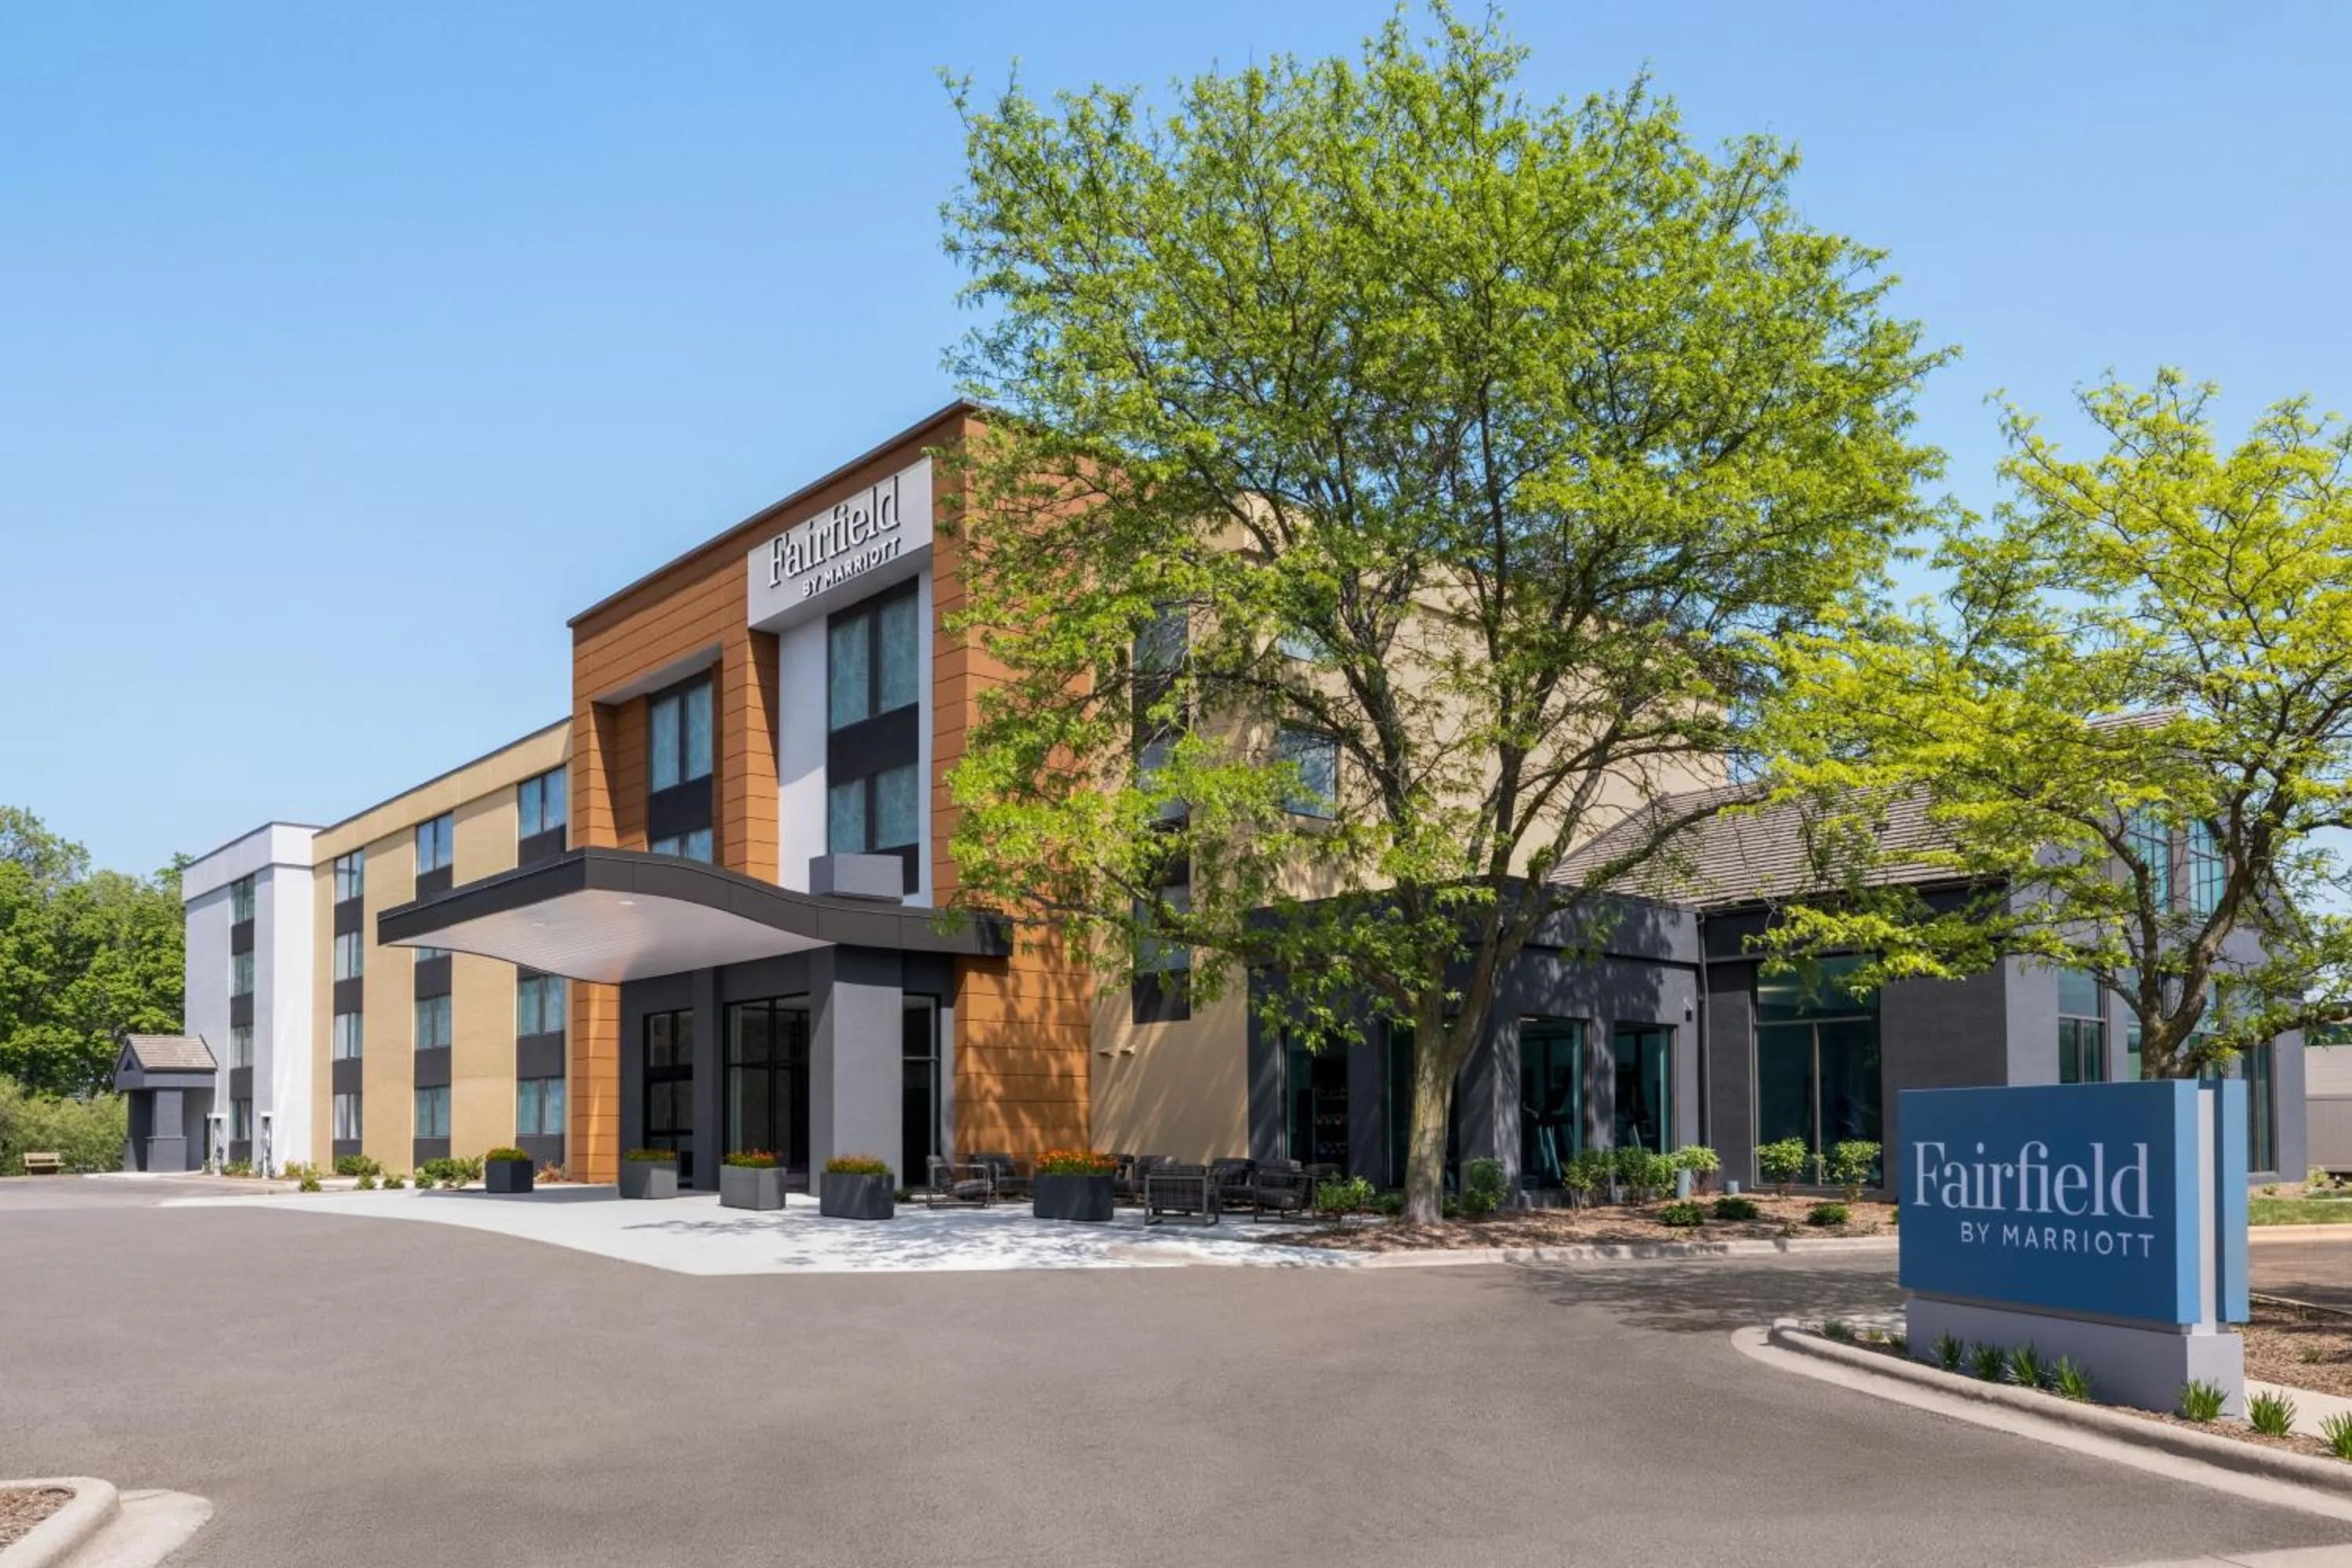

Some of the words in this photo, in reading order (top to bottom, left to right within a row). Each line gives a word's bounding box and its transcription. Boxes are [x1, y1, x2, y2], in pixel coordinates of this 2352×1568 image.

[768, 475, 900, 588] Fairfield
[803, 575, 821, 597] BY
[825, 537, 901, 587] MARRIOTT
[1913, 1141, 2154, 1218] Fairfield
[1961, 1221, 1989, 1244] BY
[2003, 1225, 2154, 1258] MARRIOTT
